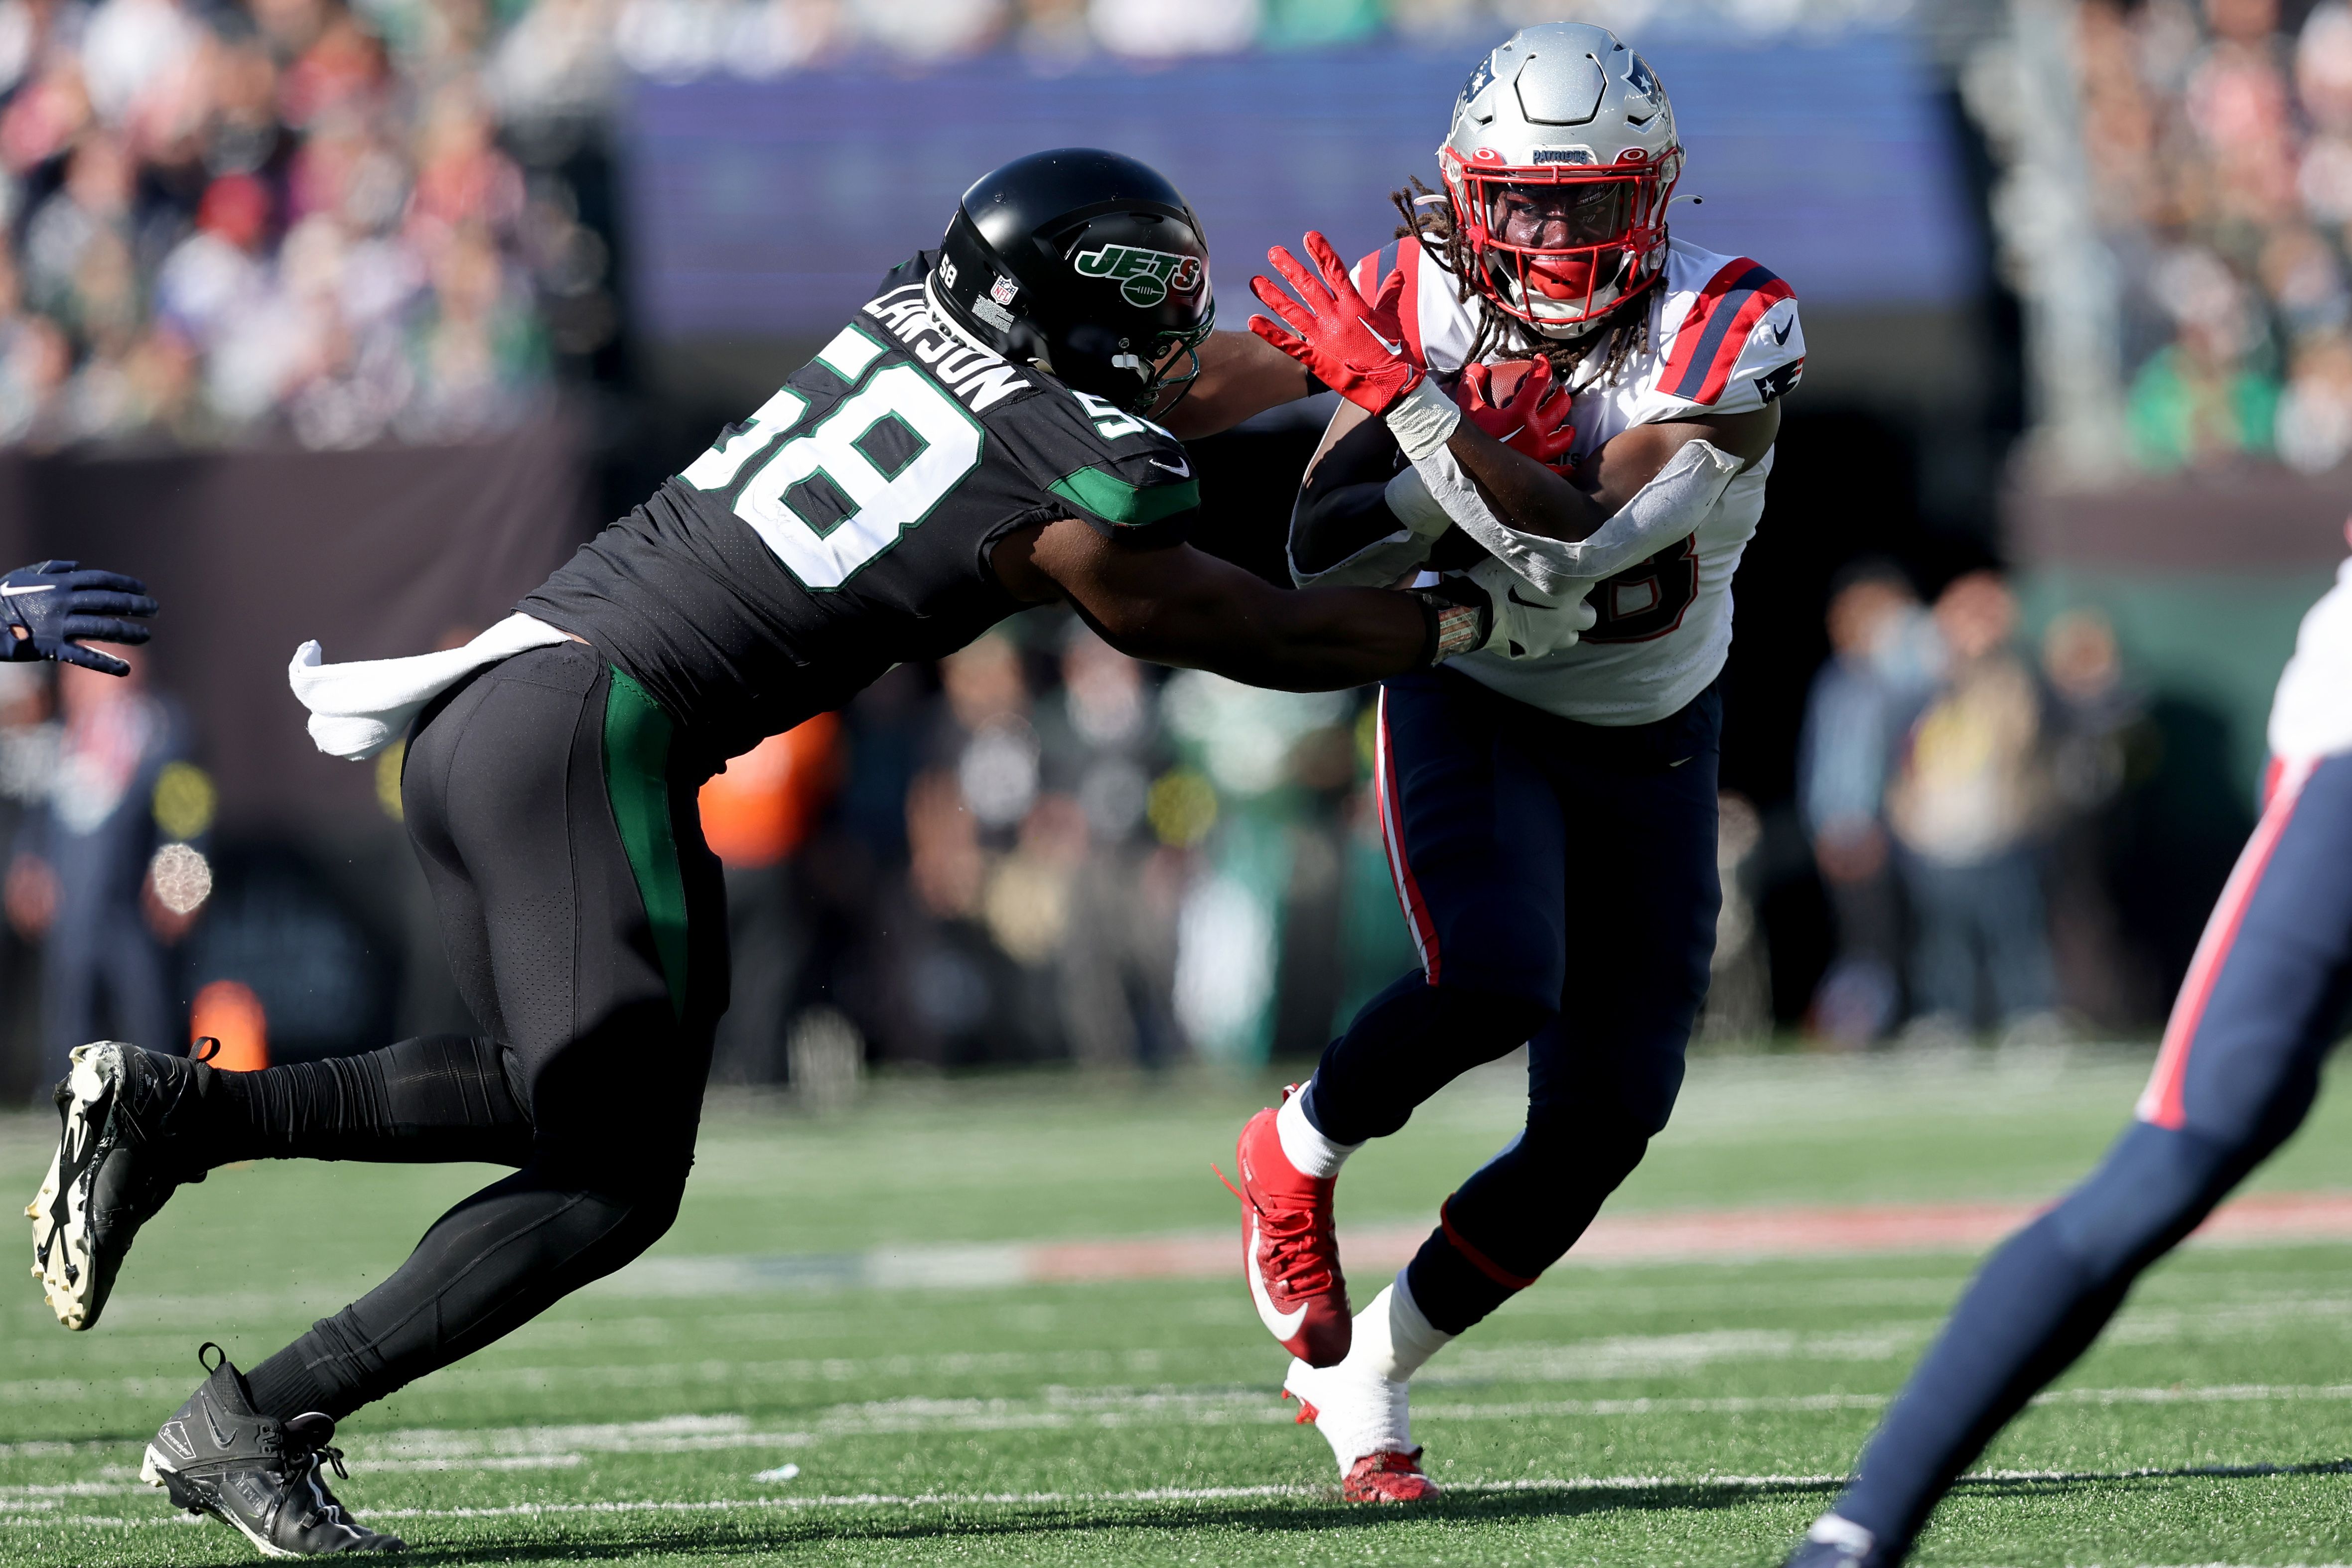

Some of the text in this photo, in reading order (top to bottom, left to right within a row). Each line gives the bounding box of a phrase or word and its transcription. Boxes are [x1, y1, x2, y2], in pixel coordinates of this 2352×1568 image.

[1533, 150, 1587, 165] PATRIOTS
[939, 253, 958, 289] 58
[1075, 244, 1201, 290] JETS
[993, 285, 1009, 302] NFL
[1067, 389, 1184, 448] 5
